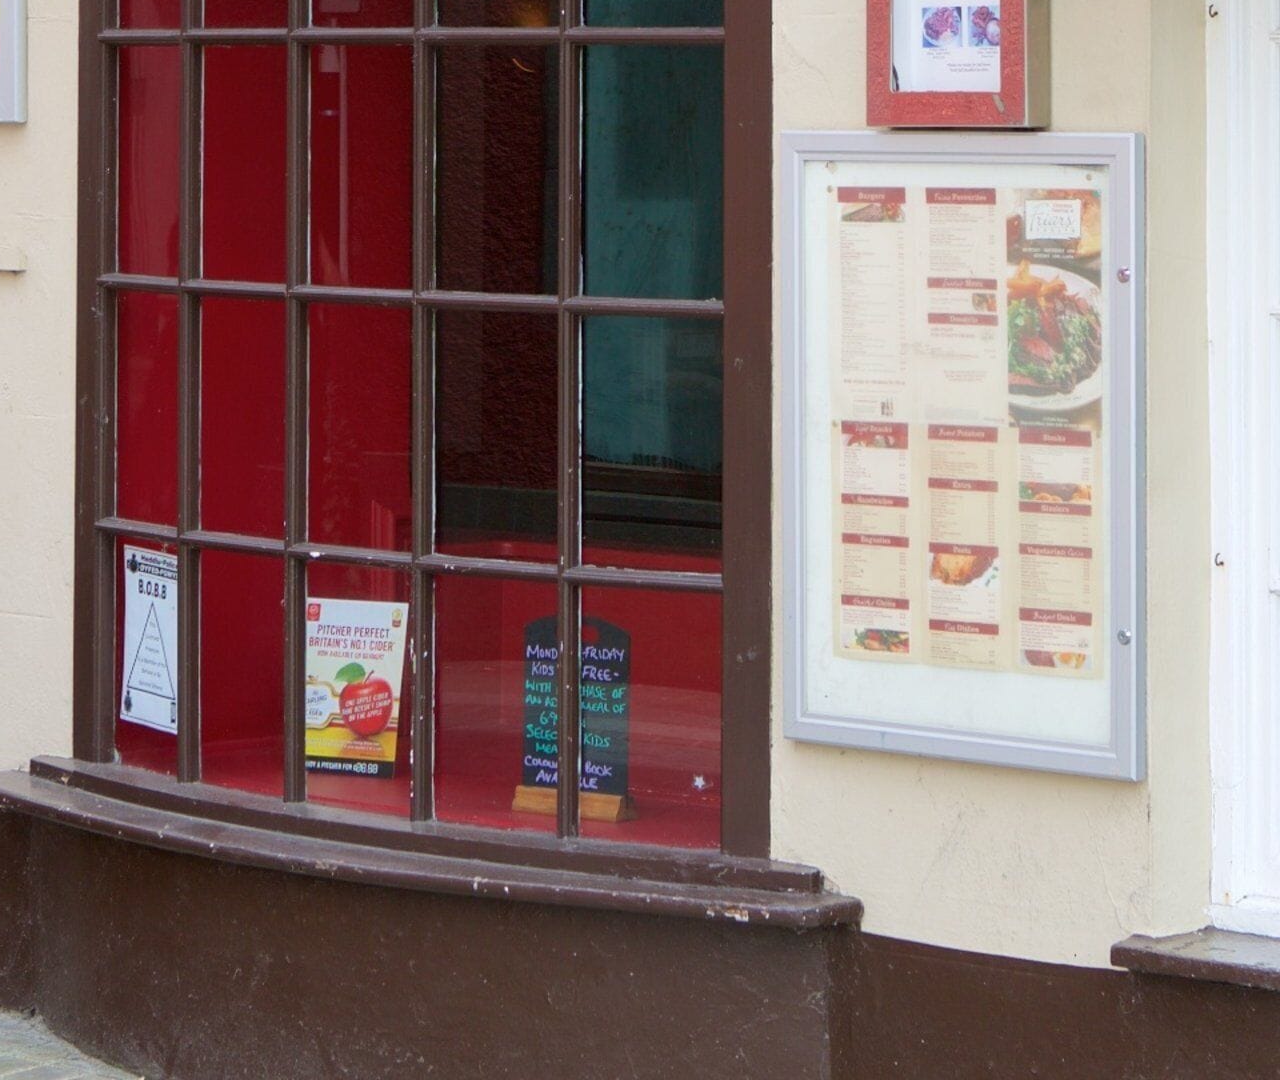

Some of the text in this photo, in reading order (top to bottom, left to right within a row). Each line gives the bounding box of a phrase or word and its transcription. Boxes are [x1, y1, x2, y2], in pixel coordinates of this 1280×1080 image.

[317, 624, 390, 638] PITCHER PERFECT
[309, 636, 348, 649] BRITAIN'S
[526, 645, 558, 660] MOND
[531, 662, 612, 681] KIDS FREE
[525, 680, 627, 700] WITH OF
[613, 703, 626, 714] OF
[526, 723, 610, 748] SELEC KIDS
[584, 760, 613, 777] BOOK
